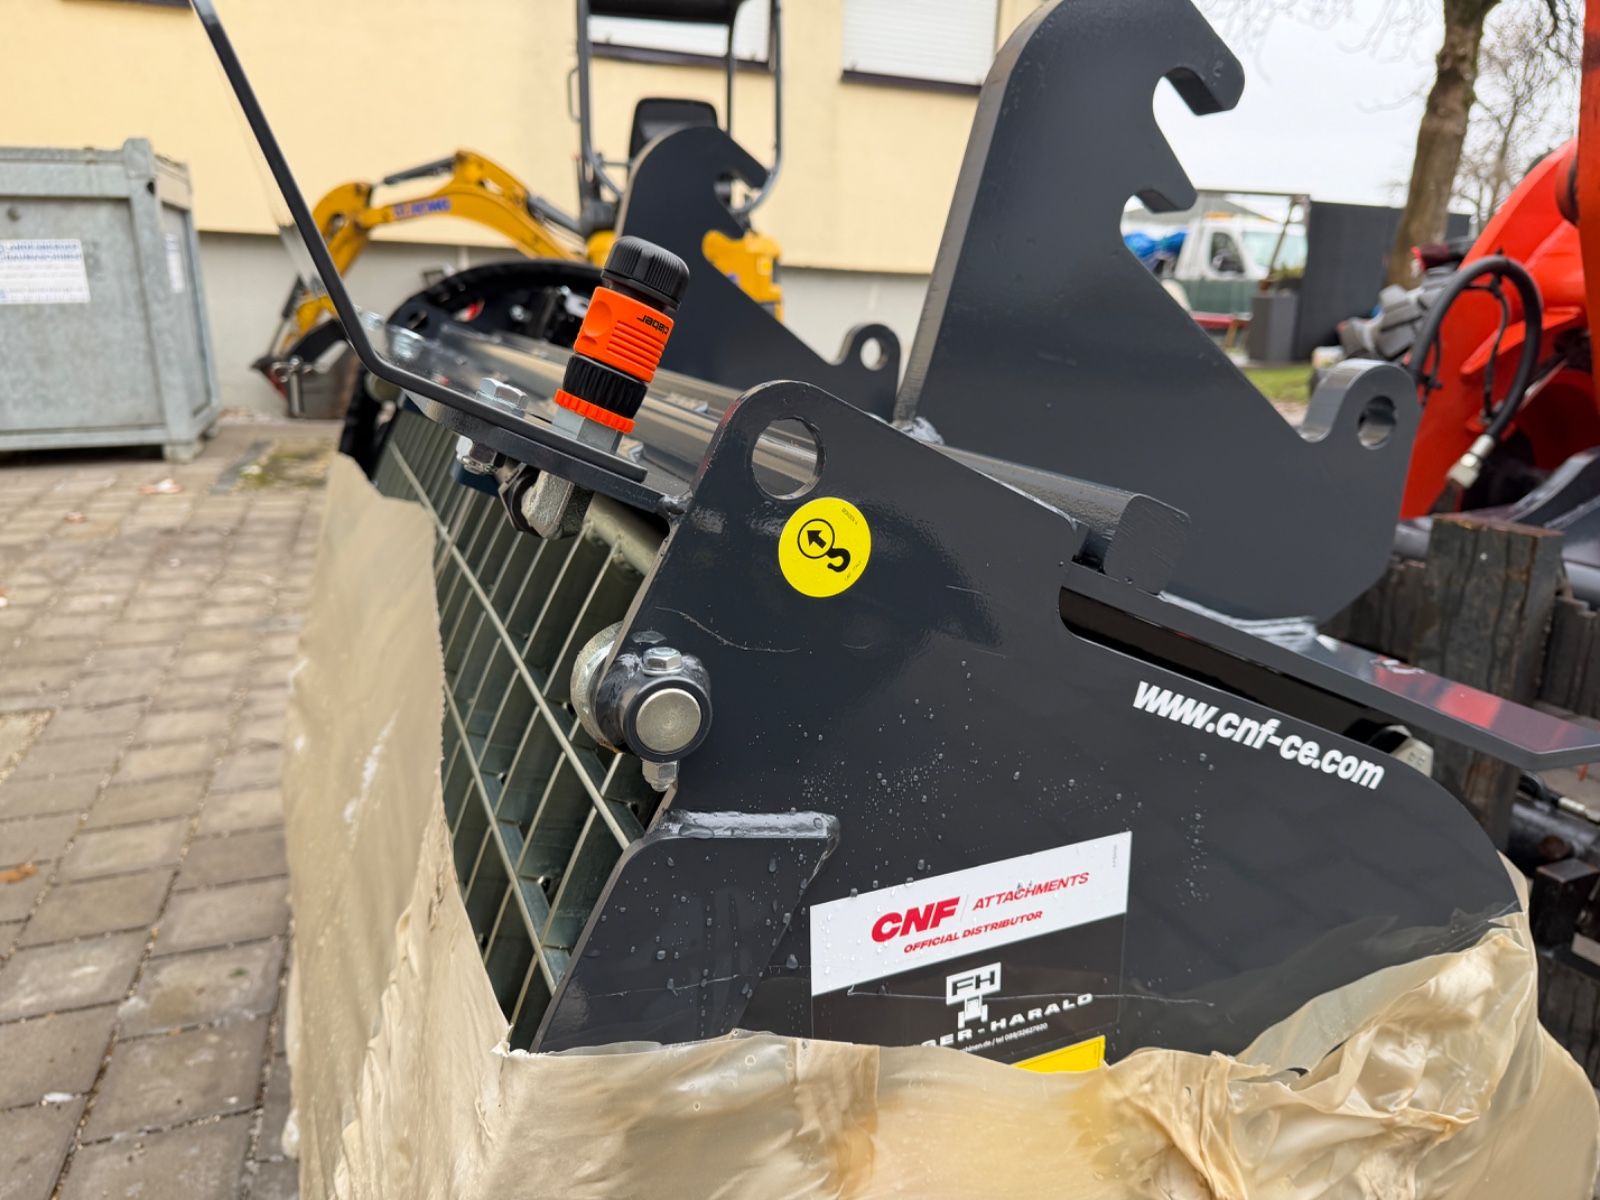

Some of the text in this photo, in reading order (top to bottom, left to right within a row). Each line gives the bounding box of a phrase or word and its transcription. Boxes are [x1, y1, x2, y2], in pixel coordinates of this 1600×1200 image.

[1132, 680, 1385, 790] www.cnf-ce.com
[871, 871, 1090, 943] CNF ATTACHMENTS
[903, 910, 1043, 954] OFFICIAL DISTRIBUTOR
[951, 969, 996, 997] FH
